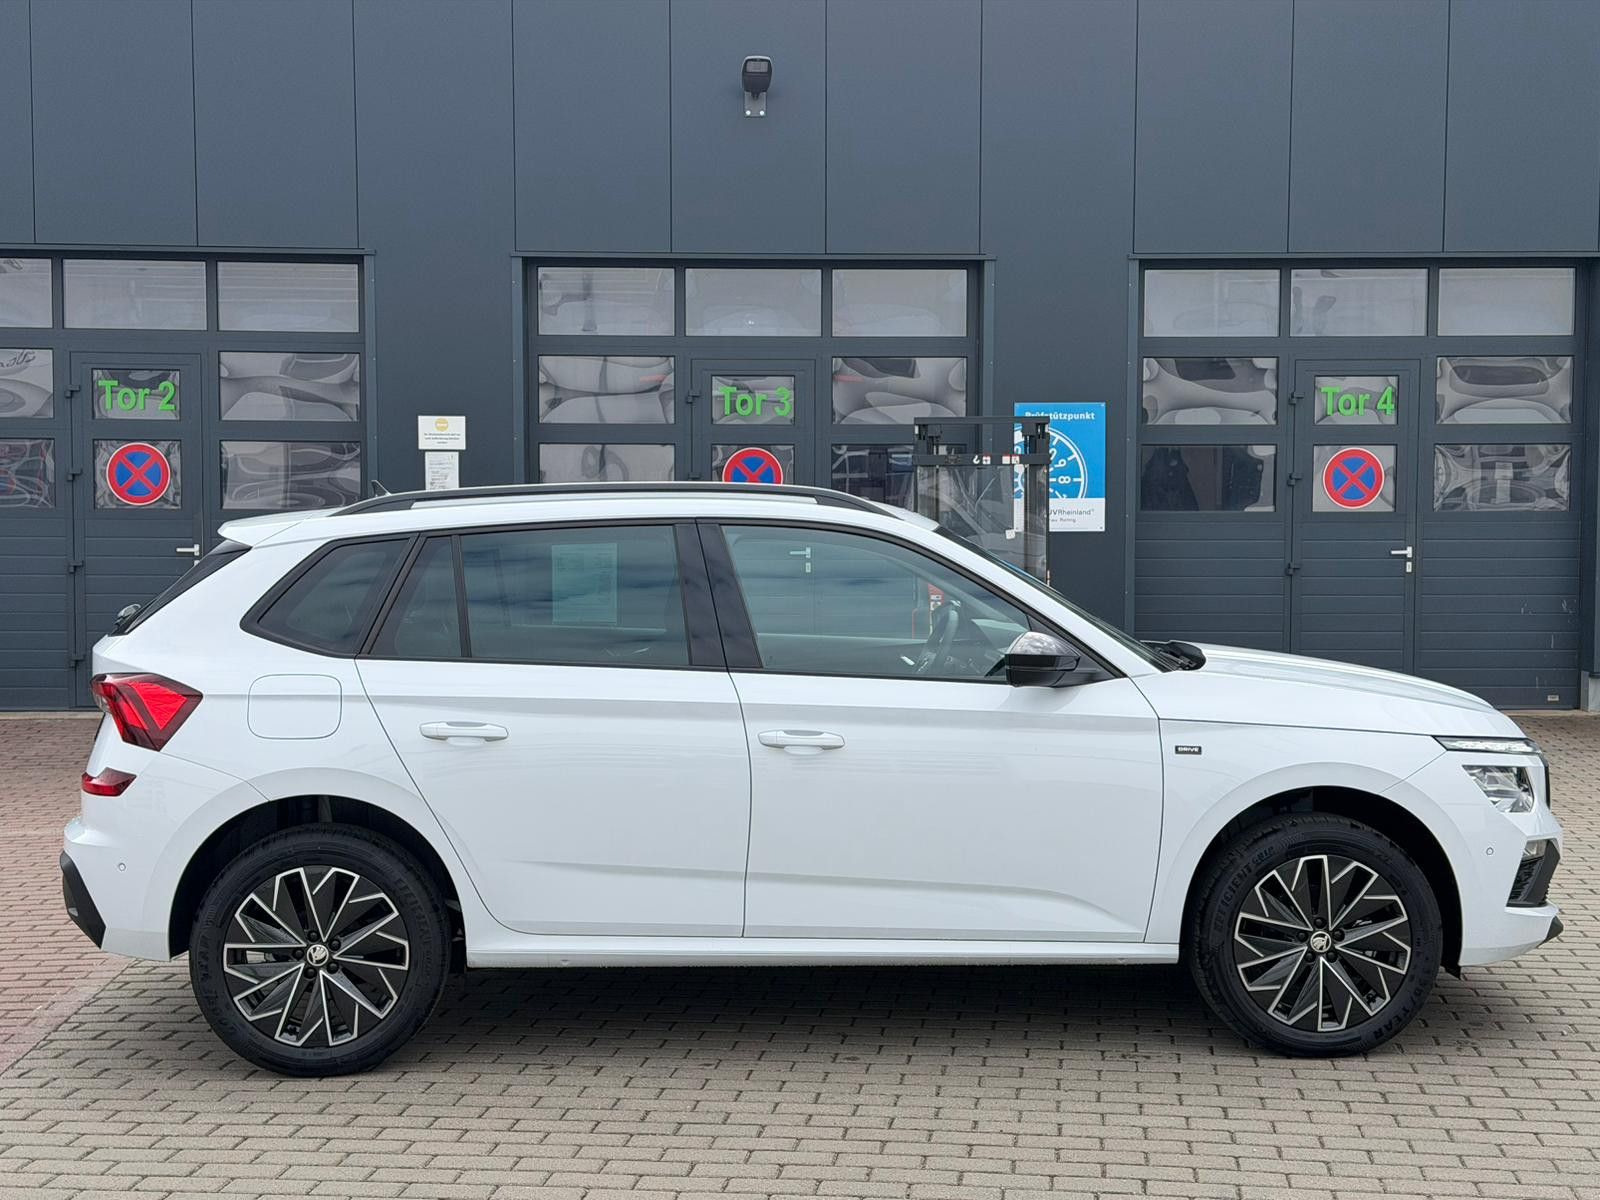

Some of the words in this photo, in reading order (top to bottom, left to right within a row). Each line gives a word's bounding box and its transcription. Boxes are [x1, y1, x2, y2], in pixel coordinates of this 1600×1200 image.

[98, 380, 150, 411] Tor
[159, 380, 176, 411] 2
[720, 386, 768, 416] Tor
[774, 386, 792, 416] 3
[1321, 386, 1370, 416] Tor
[1377, 386, 1395, 416] 4
[1058, 475, 1071, 484] 8
